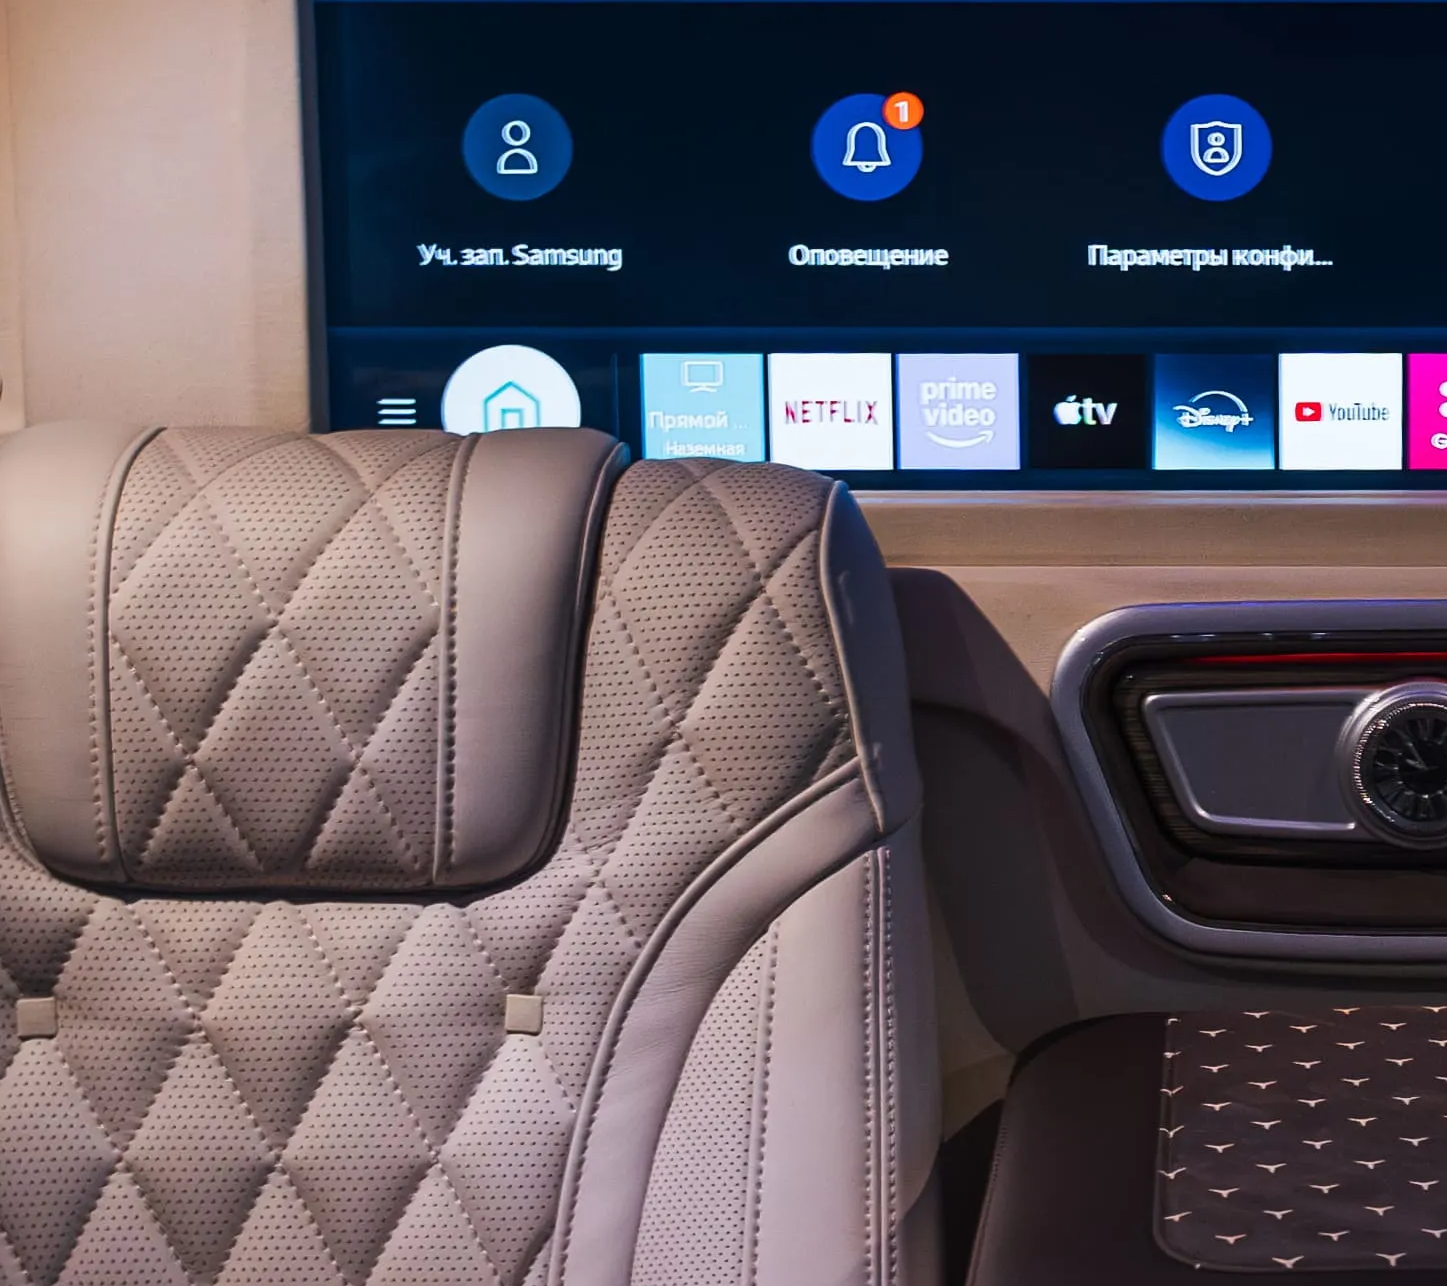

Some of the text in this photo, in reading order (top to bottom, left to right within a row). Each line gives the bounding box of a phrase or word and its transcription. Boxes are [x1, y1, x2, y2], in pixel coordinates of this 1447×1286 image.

[893, 100, 909, 123] 1
[417, 244, 623, 270] Уч. зап. Samsung
[788, 244, 949, 269] Оповещение
[1087, 244, 1333, 271] Параметры конфи...
[921, 377, 997, 404] prime
[649, 411, 728, 431] Прямой
[785, 400, 878, 424] NETFLIX
[921, 403, 997, 427] video
[1329, 403, 1390, 422] YouTube
[666, 442, 744, 457] Наземная
